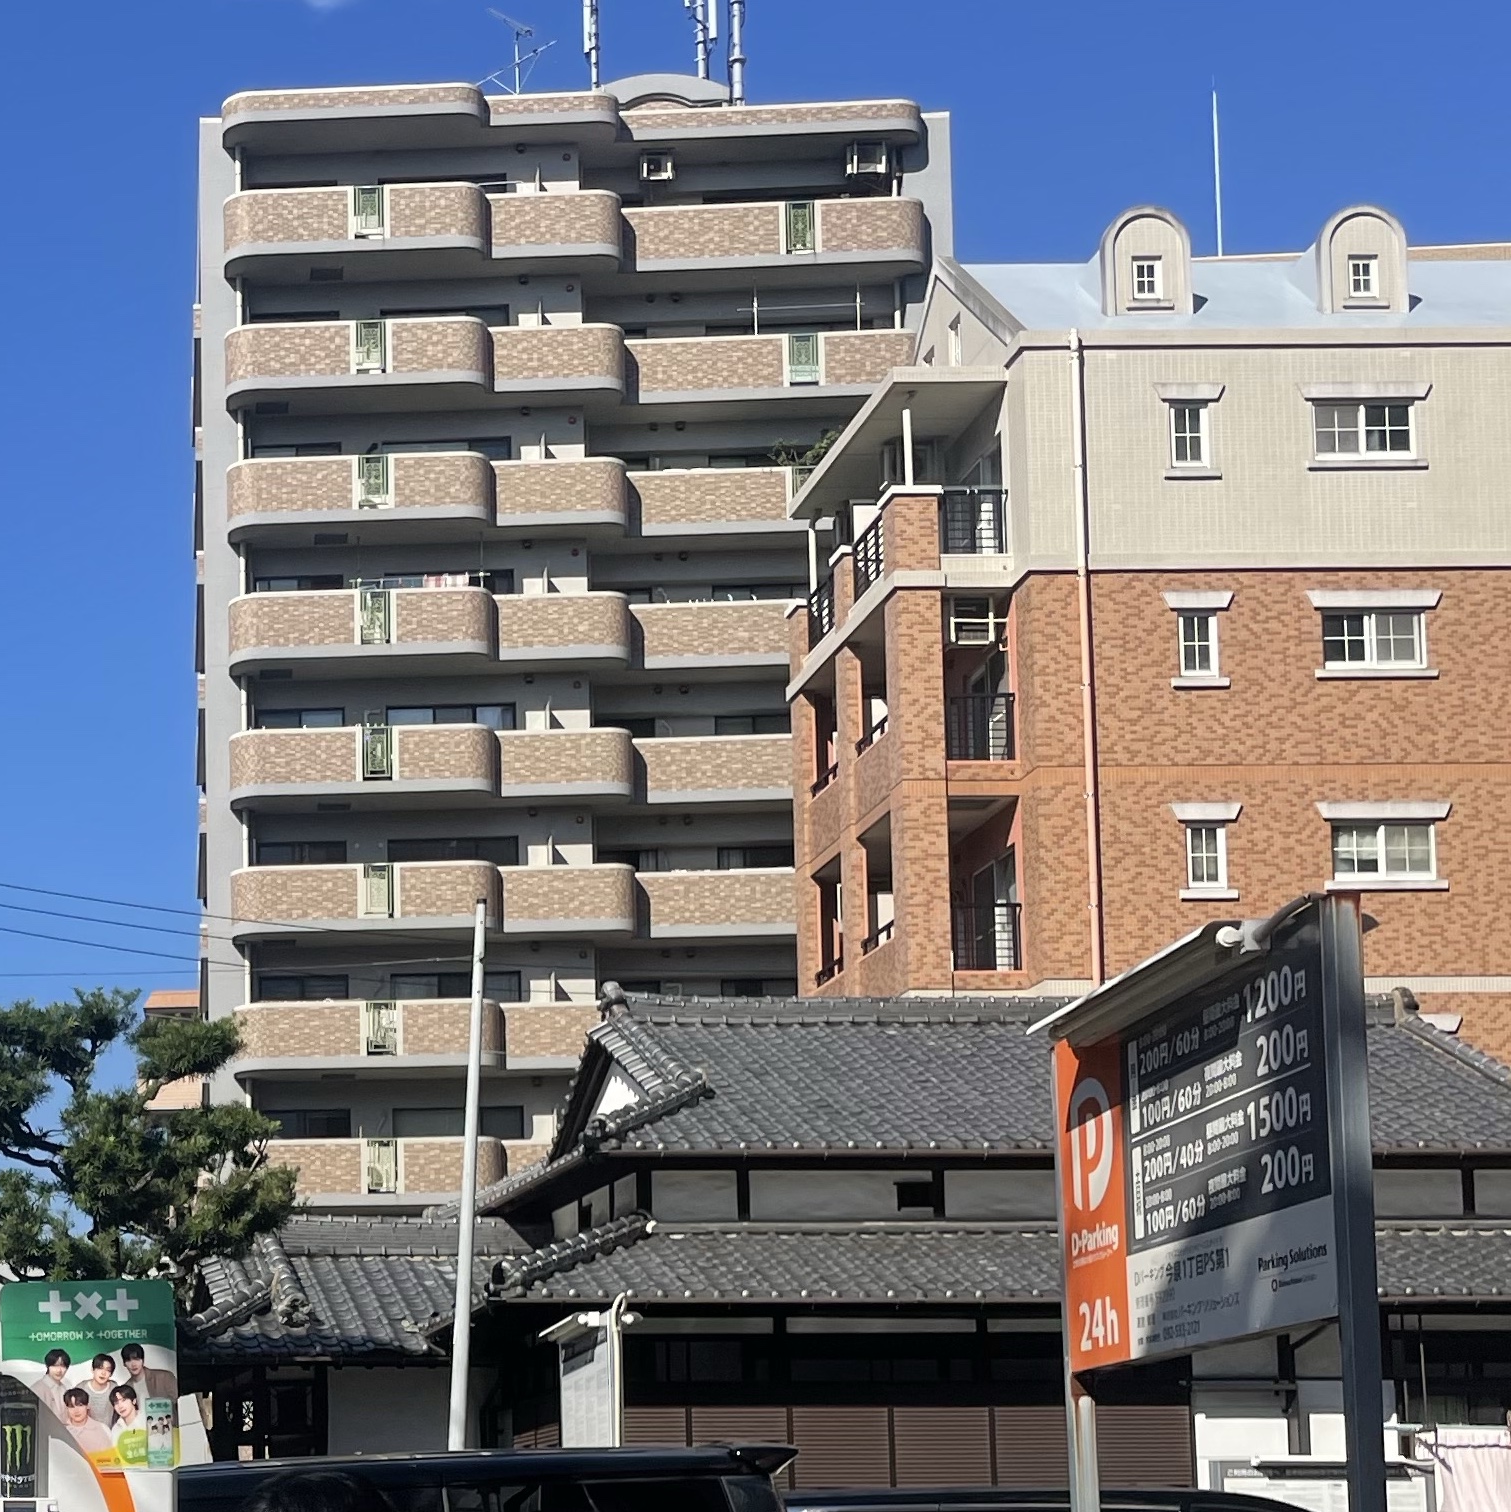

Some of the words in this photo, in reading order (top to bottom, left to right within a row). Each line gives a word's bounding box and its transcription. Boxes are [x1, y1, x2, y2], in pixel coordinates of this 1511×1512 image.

[1243, 965, 1306, 1022] 1200円
[1139, 1026, 1200, 1076] 200円/60分
[1256, 1024, 1309, 1077] 200円
[1142, 1081, 1202, 1128] 100円/60分
[1247, 1086, 1311, 1141] 1500円
[1144, 1139, 1204, 1183] 200円/40分
[1260, 1146, 1314, 1194] 200円
[1146, 1194, 1206, 1235] 100円/60分
[1072, 1221, 1119, 1257] D-Parking
[1258, 1250, 1289, 1272] Parking
[1289, 1243, 1328, 1264] Solutions
[1079, 1296, 1119, 1352] 24h
